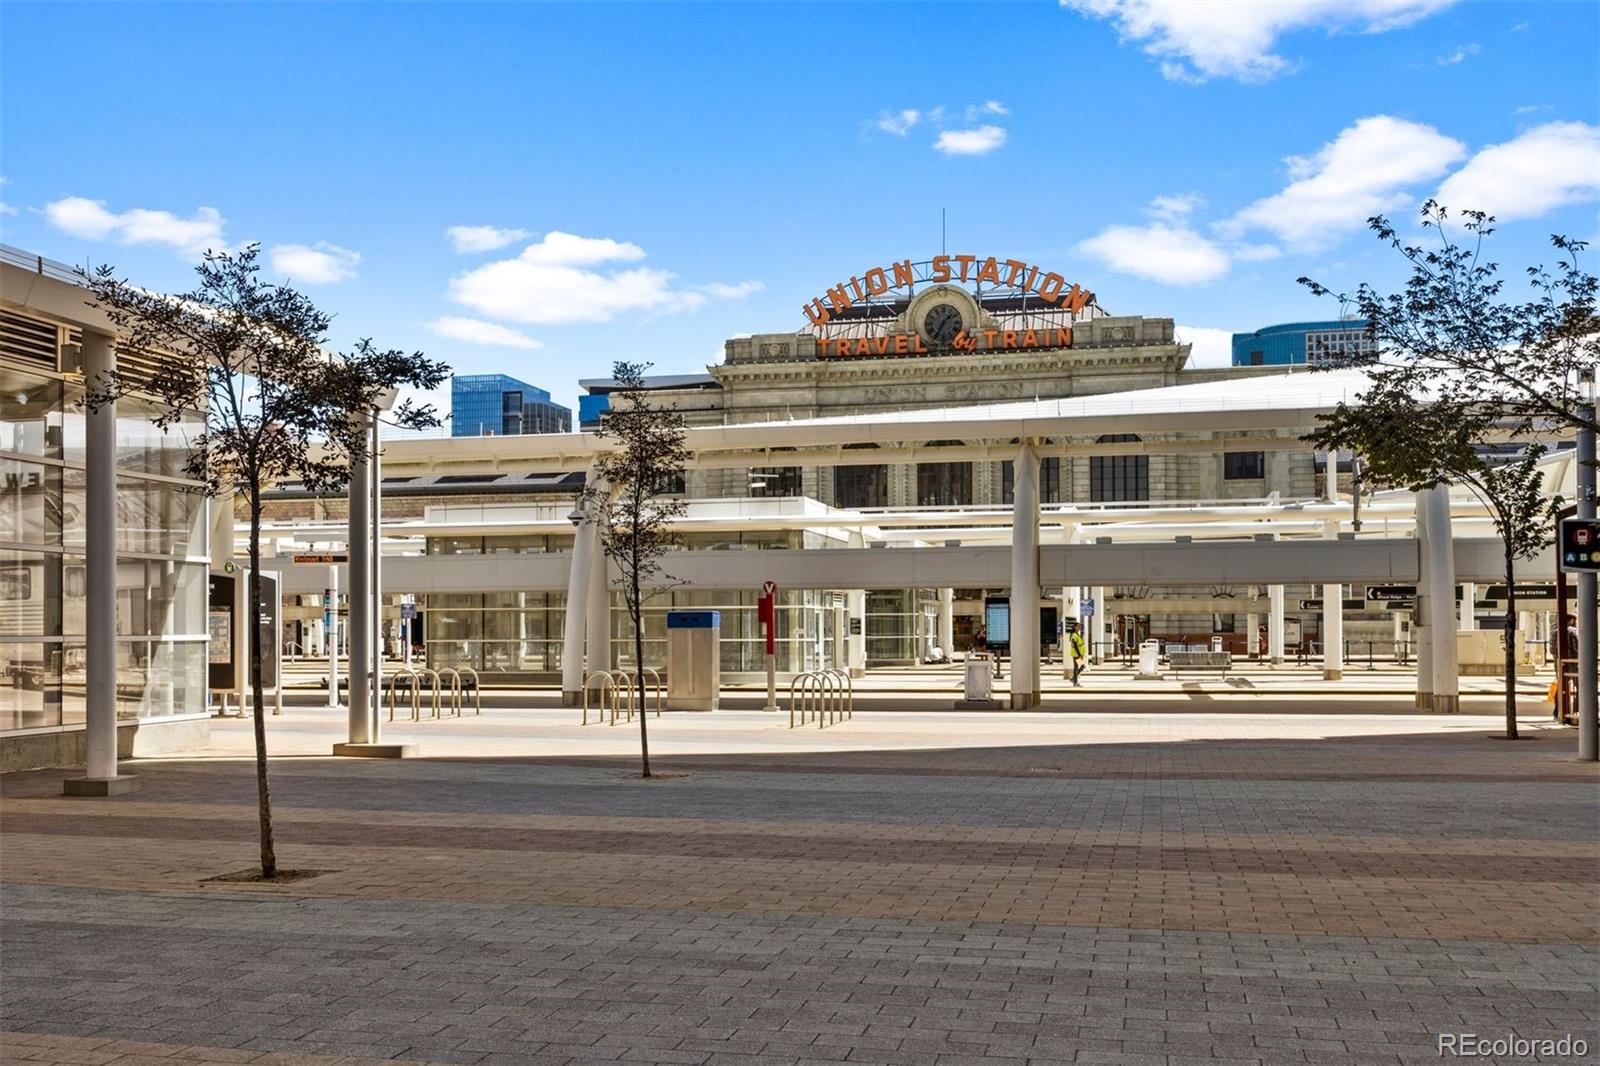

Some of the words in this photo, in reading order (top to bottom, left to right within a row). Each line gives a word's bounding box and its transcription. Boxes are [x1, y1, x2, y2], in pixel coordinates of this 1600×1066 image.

[803, 259, 913, 326] UNION
[932, 254, 1090, 315] STATION
[816, 334, 928, 356] TRAVEL
[952, 330, 976, 354] by
[983, 327, 1073, 349] TRAIN
[864, 386, 927, 401] UNION
[944, 381, 1024, 399] STATION
[1567, 553, 1574, 561] A
[1580, 553, 1588, 561] B
[765, 583, 774, 593] V
